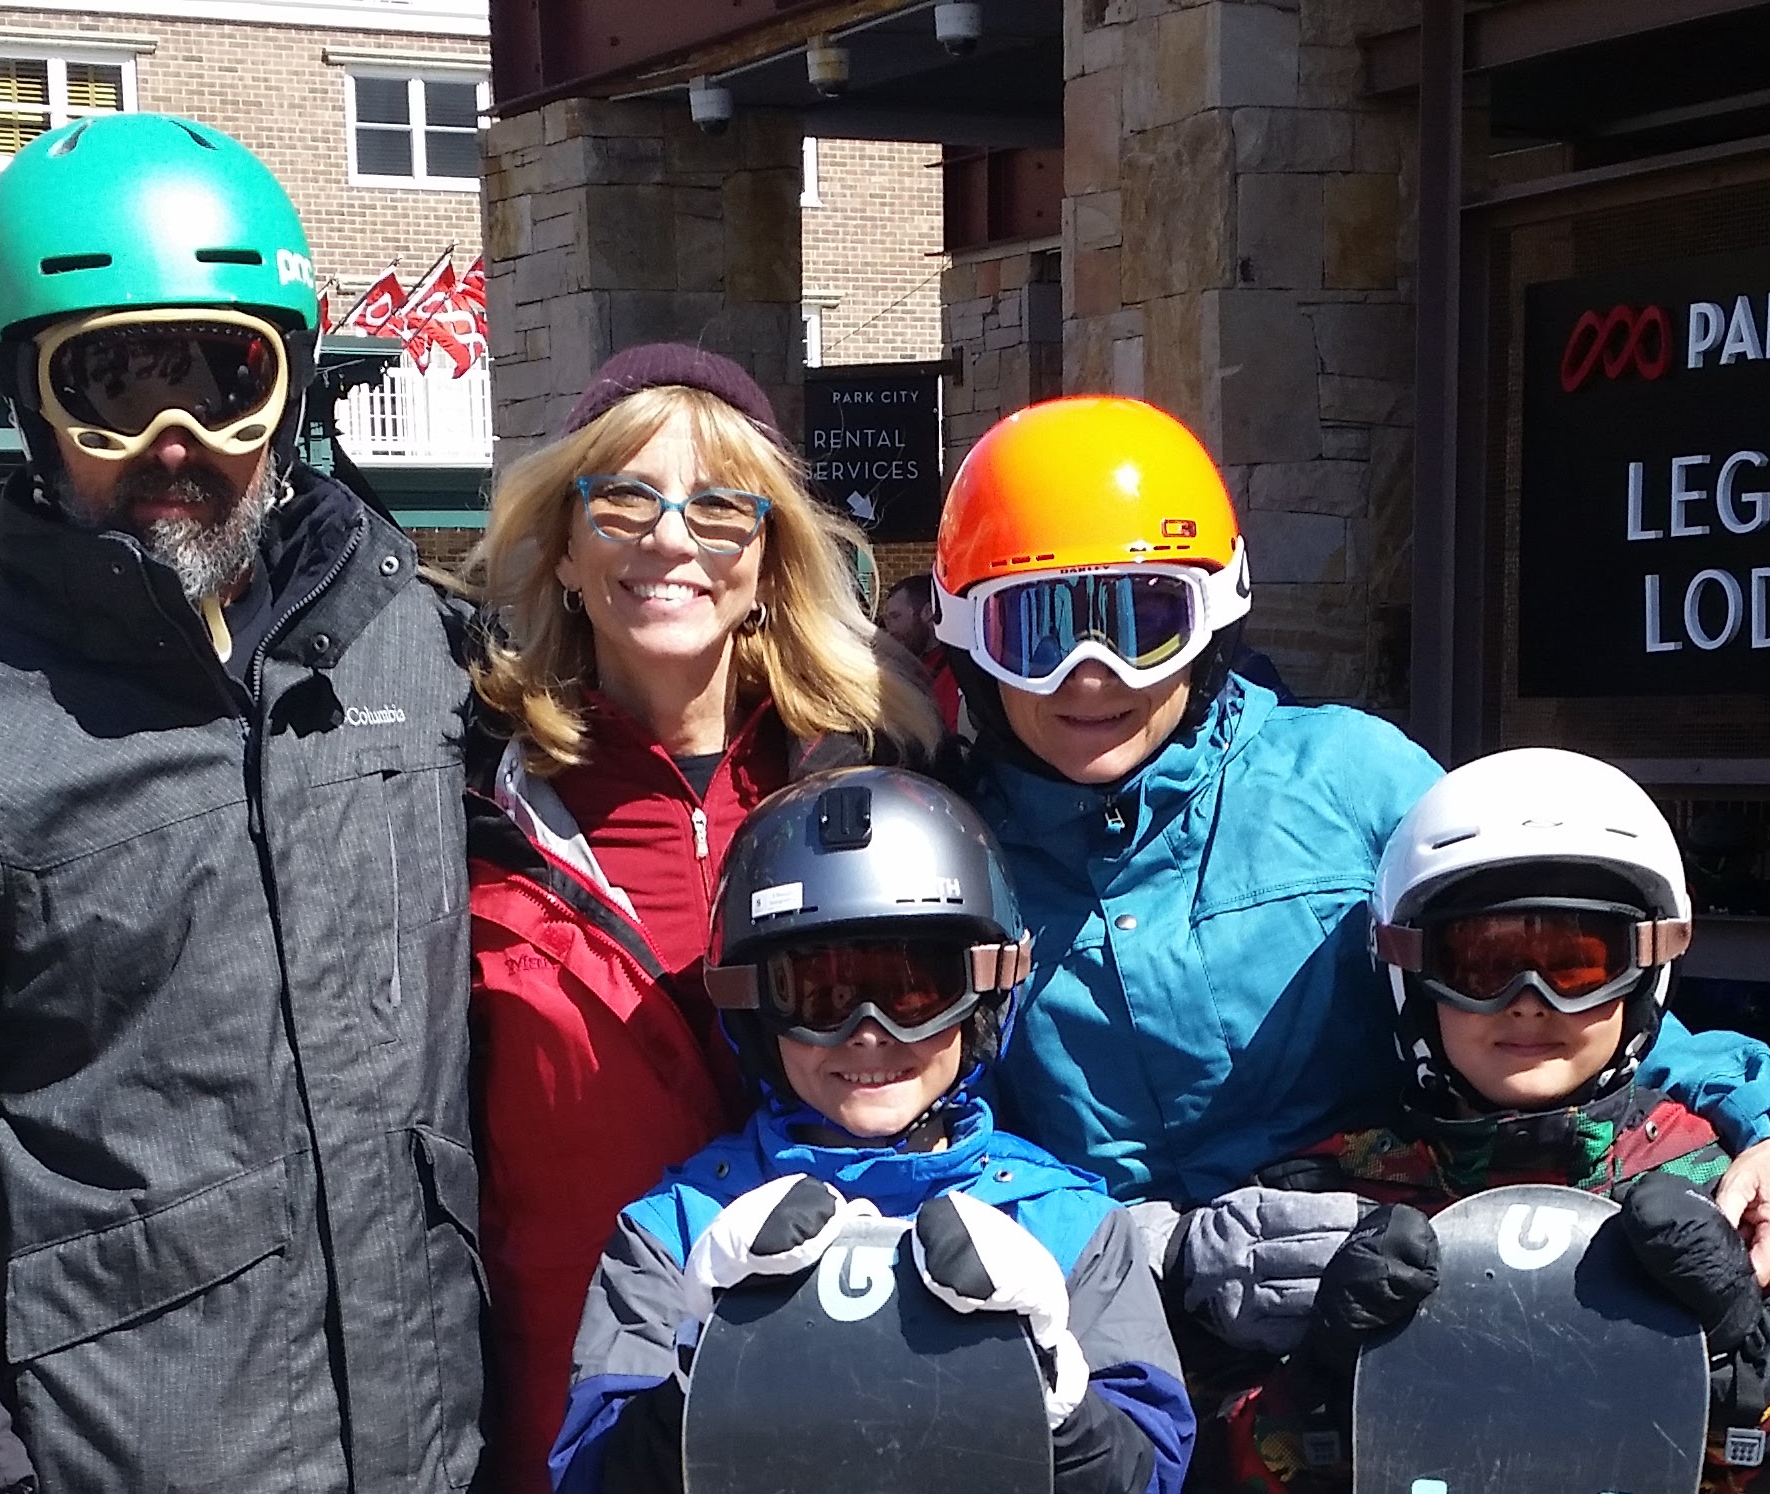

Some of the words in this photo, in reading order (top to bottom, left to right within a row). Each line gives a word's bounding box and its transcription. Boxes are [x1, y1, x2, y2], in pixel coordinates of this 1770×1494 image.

[832, 391, 874, 404] PARK
[880, 390, 919, 404] CITY
[813, 429, 907, 449] RENTAL
[346, 703, 406, 726] Columbia
